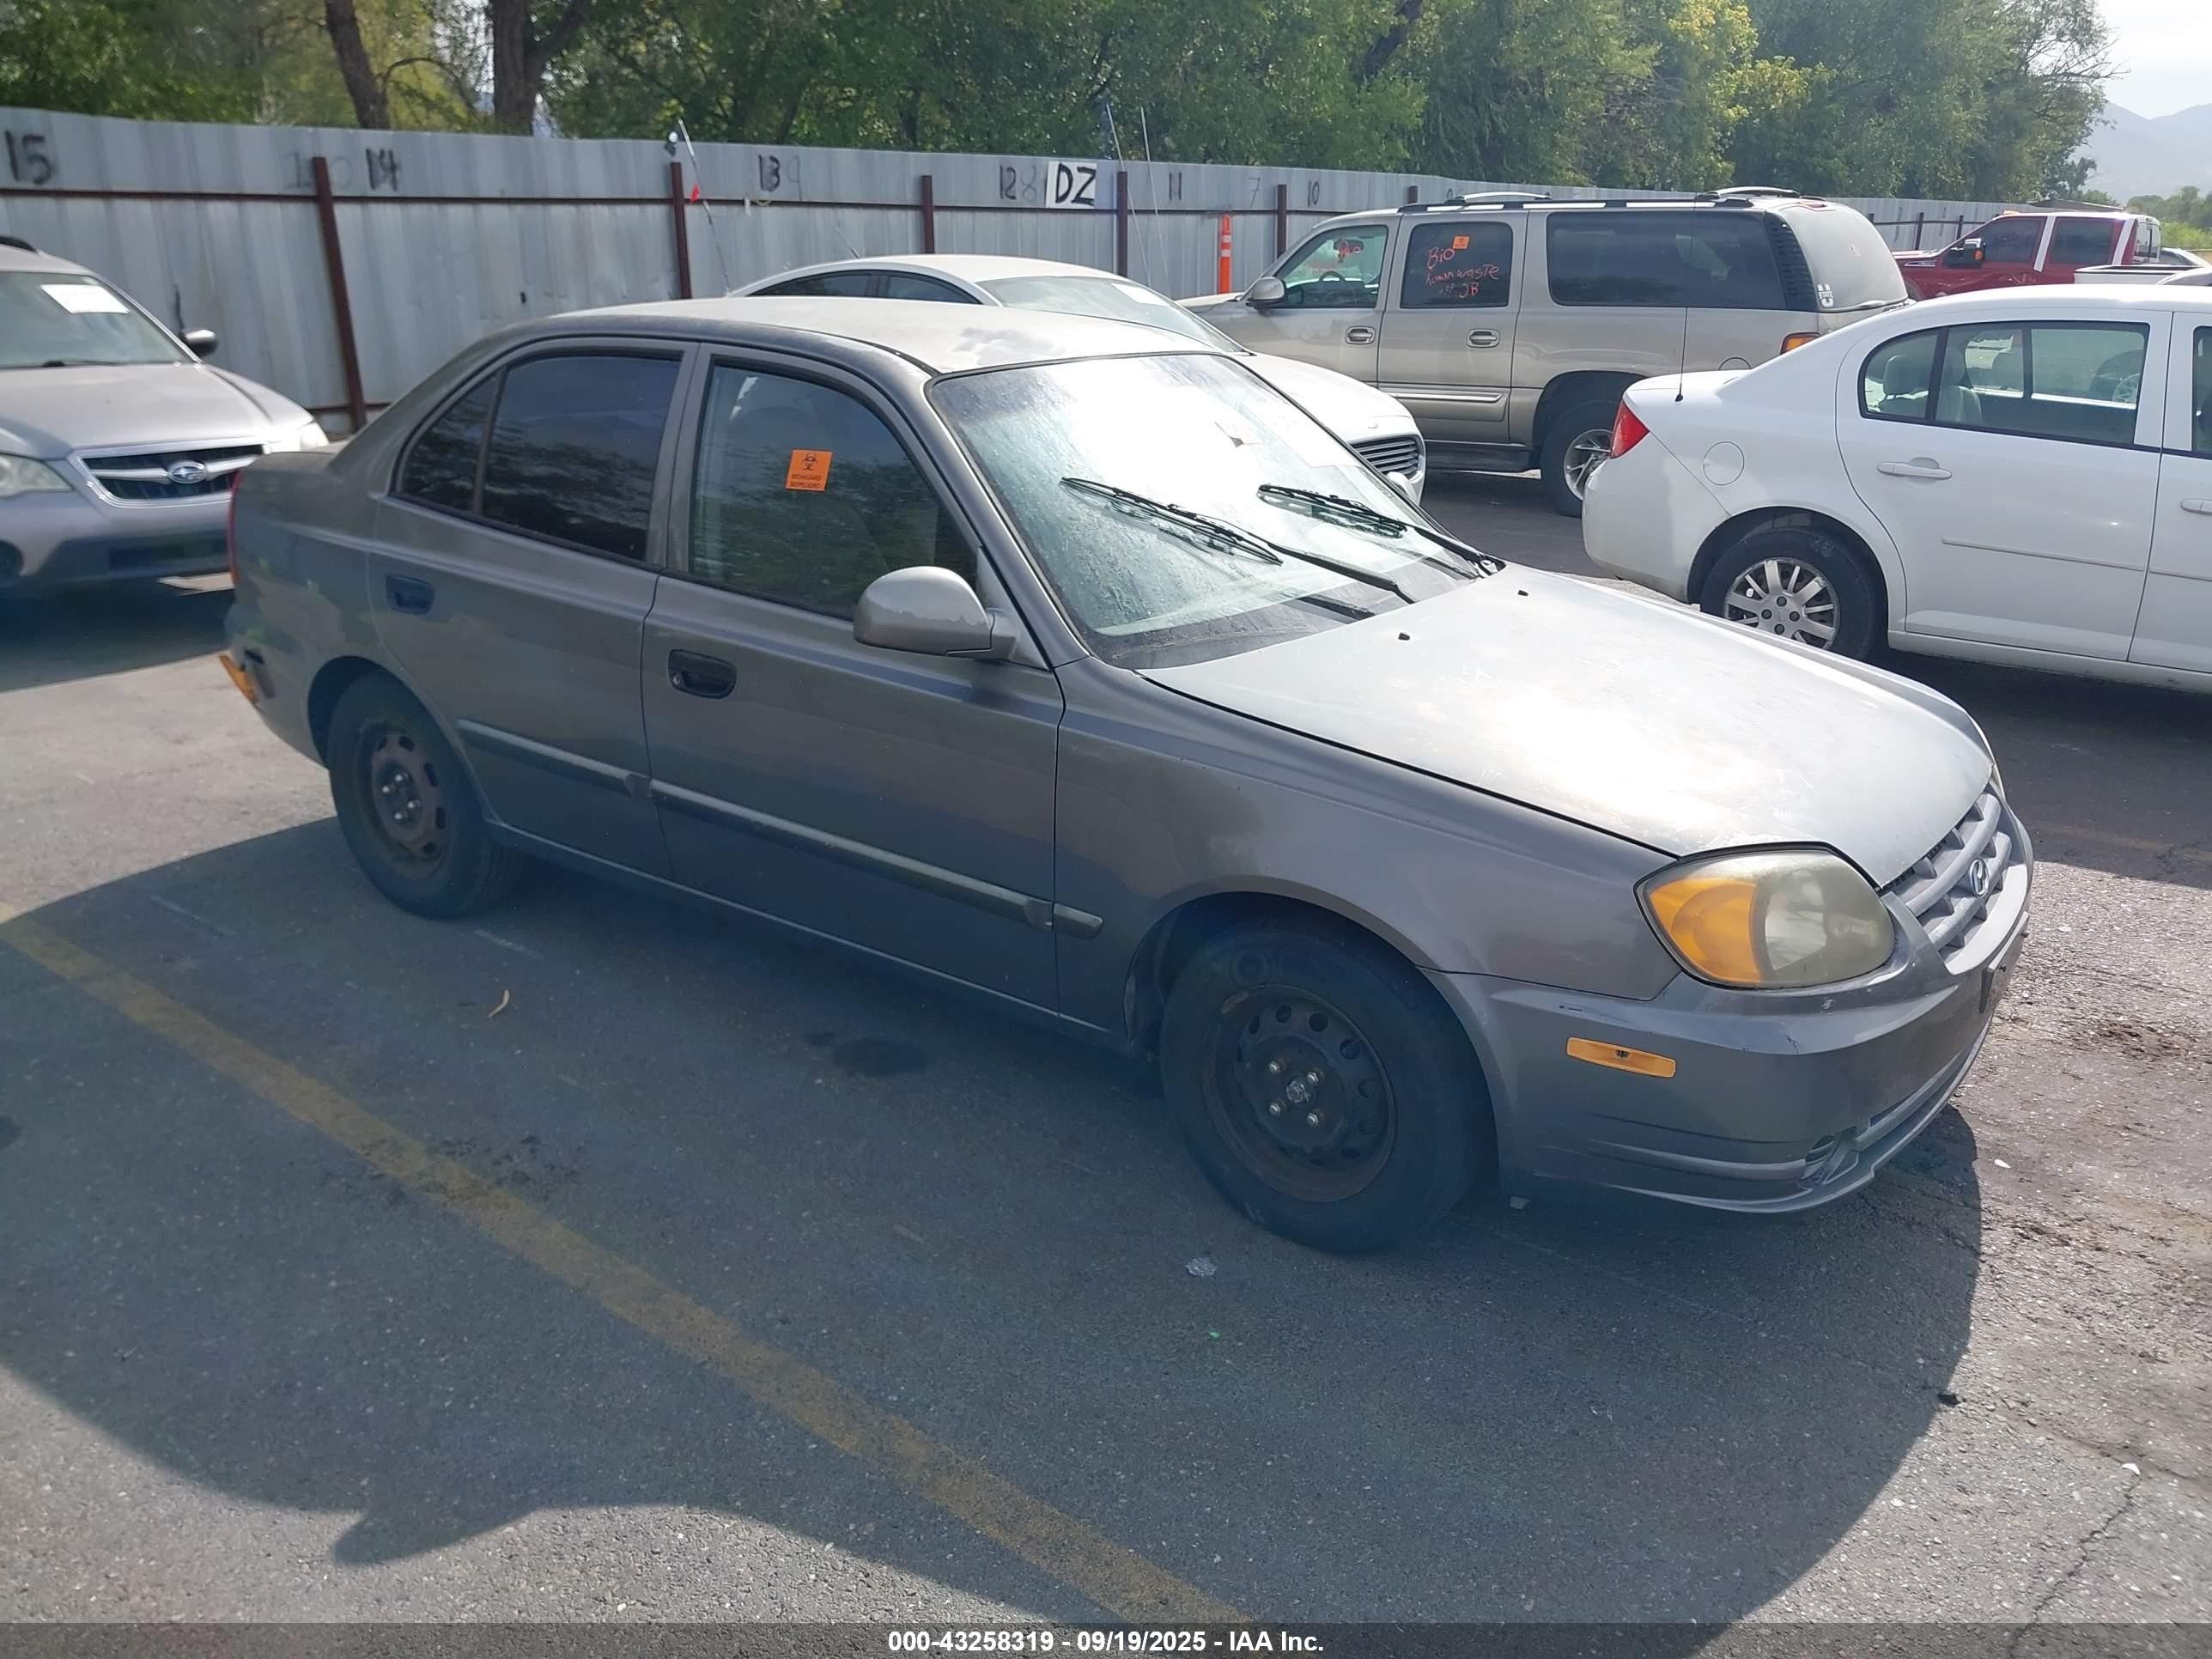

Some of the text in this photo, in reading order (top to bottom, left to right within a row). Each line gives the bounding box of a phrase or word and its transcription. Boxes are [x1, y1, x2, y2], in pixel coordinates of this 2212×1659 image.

[4, 130, 54, 185] 15
[366, 148, 399, 191] 14
[757, 155, 781, 192] 13
[999, 165, 1017, 200] 12
[1054, 162, 1097, 206] DZ
[1307, 180, 1321, 208] 10
